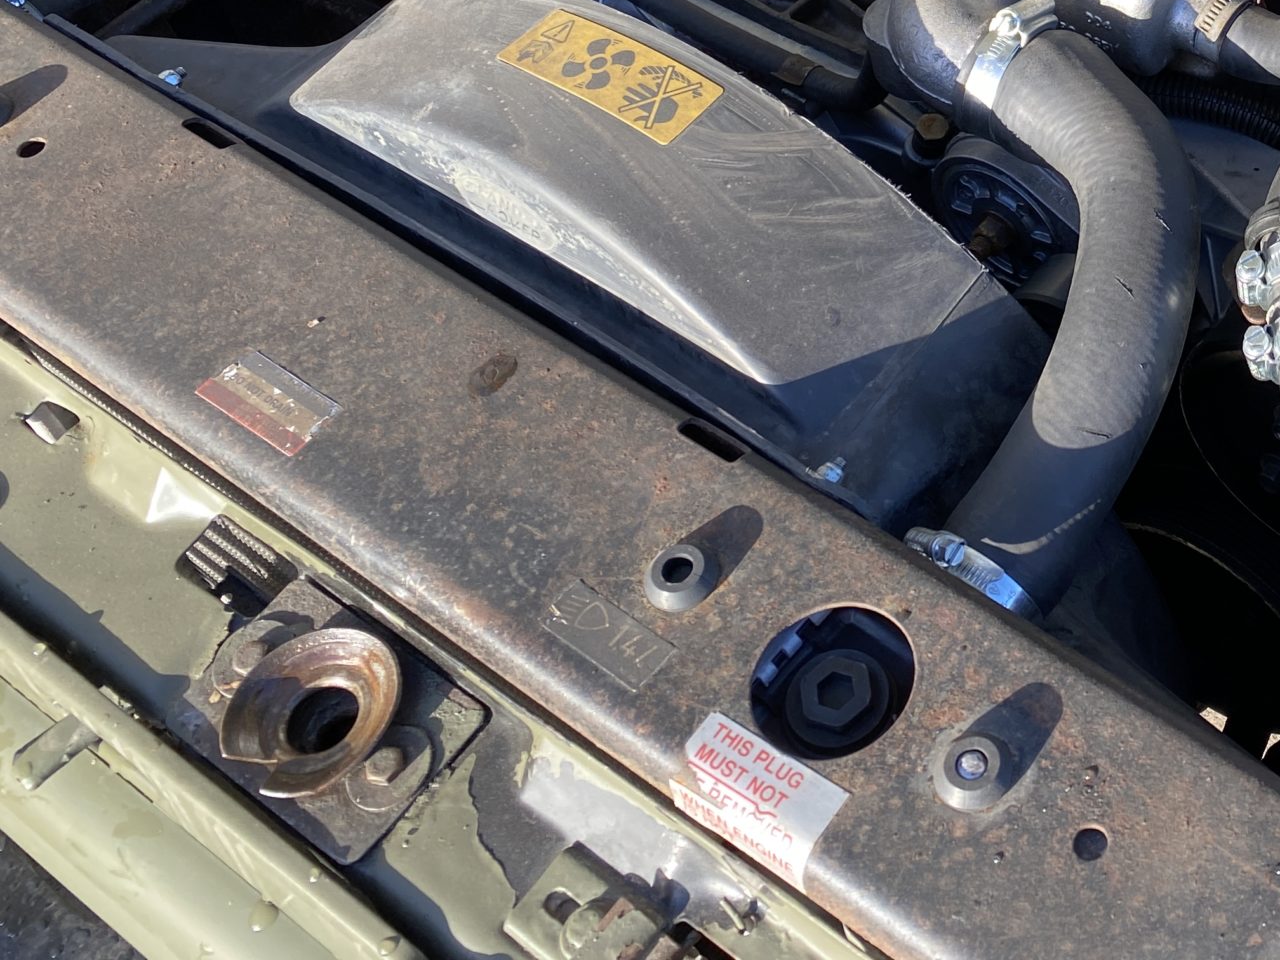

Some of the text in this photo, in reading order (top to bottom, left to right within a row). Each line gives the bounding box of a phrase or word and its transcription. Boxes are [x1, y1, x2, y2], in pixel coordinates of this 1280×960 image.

[245, 381, 265, 398] NOT
[265, 394, 297, 417] DRAIN
[694, 743, 749, 783] MUST
[746, 776, 790, 809] NOT
[713, 722, 804, 790] THIS PLUG
[682, 791, 731, 833] WHEN
[732, 826, 793, 873] ENGINE
